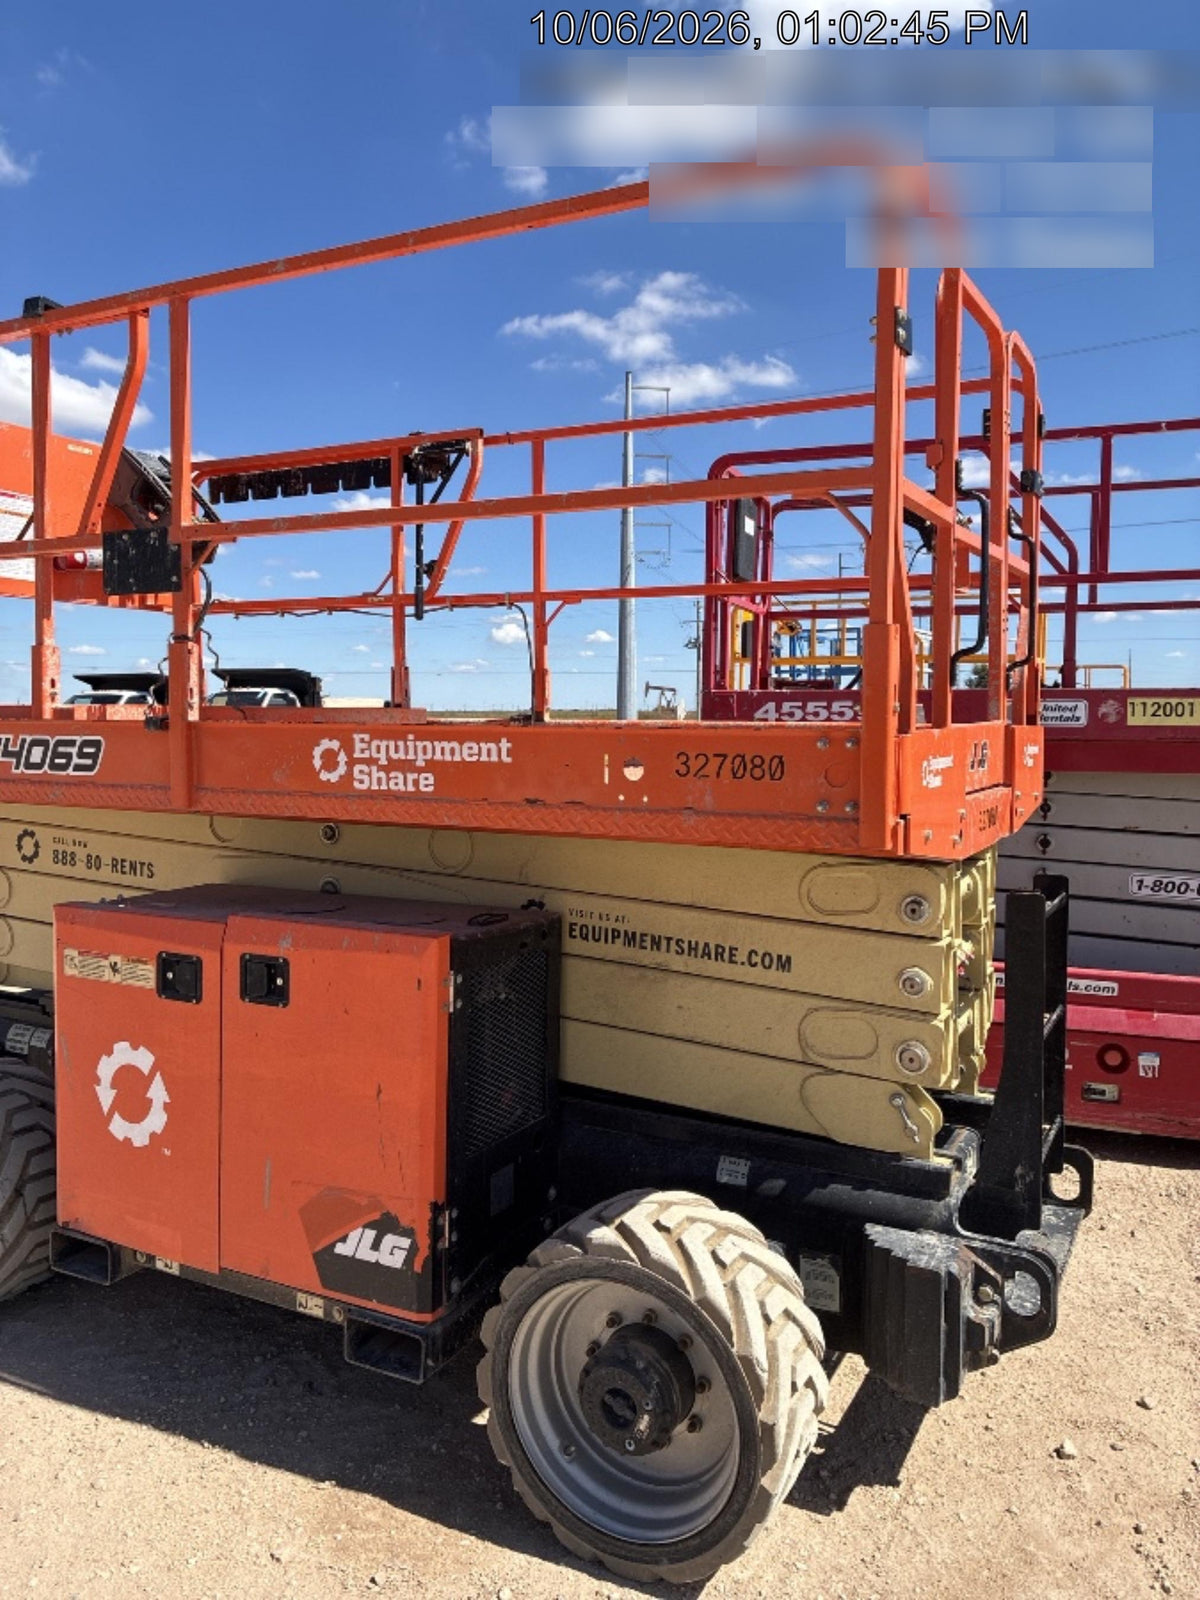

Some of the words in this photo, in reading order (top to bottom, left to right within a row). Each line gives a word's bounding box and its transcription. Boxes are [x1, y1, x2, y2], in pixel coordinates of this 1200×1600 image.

[753, 701, 862, 722] 4555
[1129, 701, 1194, 717] 112001
[0, 735, 105, 775] 4069
[353, 733, 512, 766] Equipment
[353, 765, 434, 791] Share
[675, 752, 785, 781] 327080
[52, 849, 155, 879] 888-80-RENTS
[568, 922, 792, 973] EQUIPMENTSHARE.COM
[334, 1227, 412, 1269] JLG
